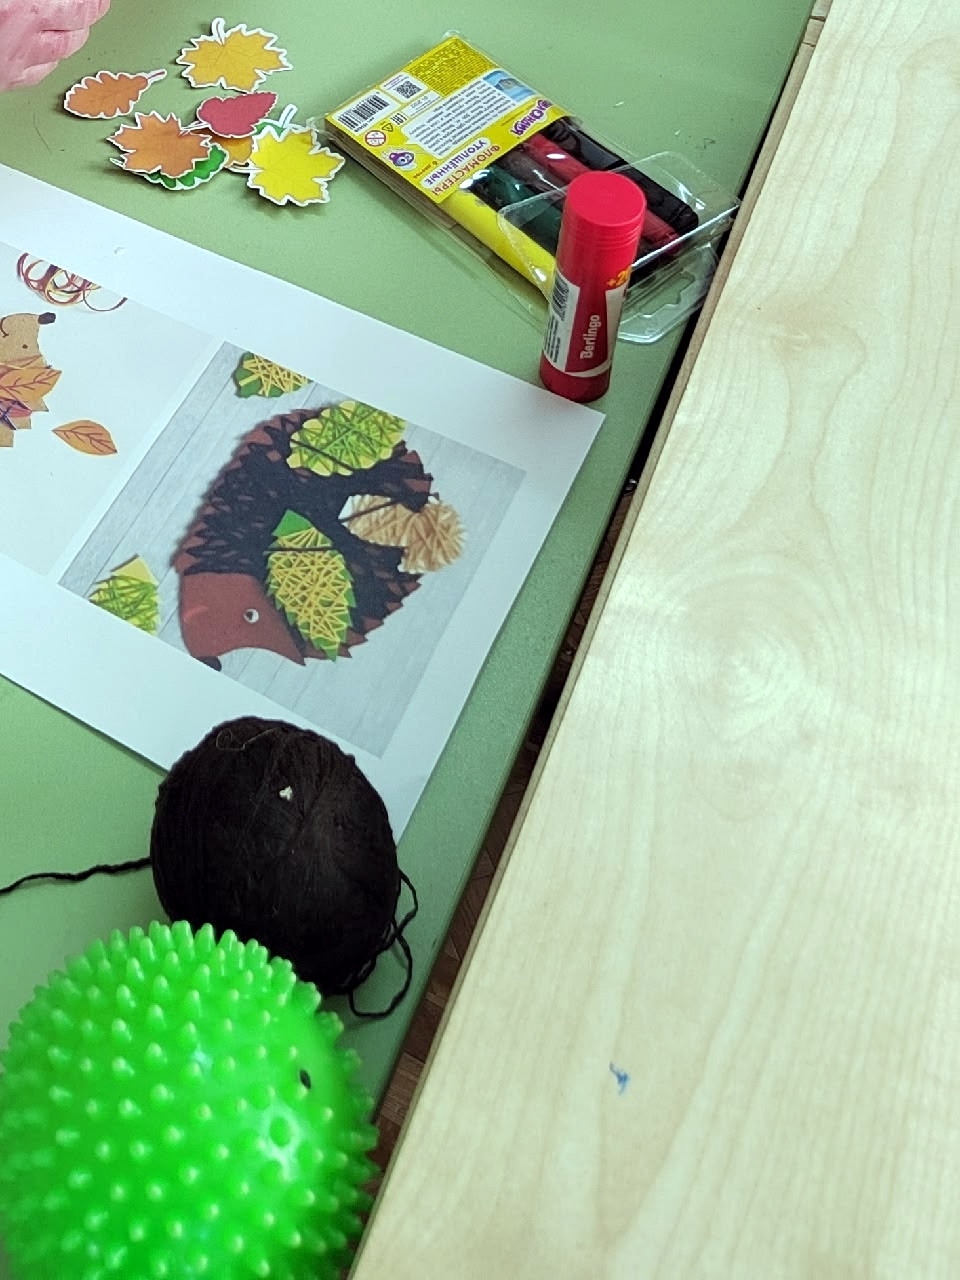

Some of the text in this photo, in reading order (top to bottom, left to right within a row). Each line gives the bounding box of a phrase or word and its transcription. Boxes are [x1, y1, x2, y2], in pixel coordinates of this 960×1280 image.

[423, 139, 488, 186] УТОЛЩЁННЫЕ
[431, 144, 501, 196] ФЛОМАСТЕРЫ
[580, 314, 602, 359] Berlingo
